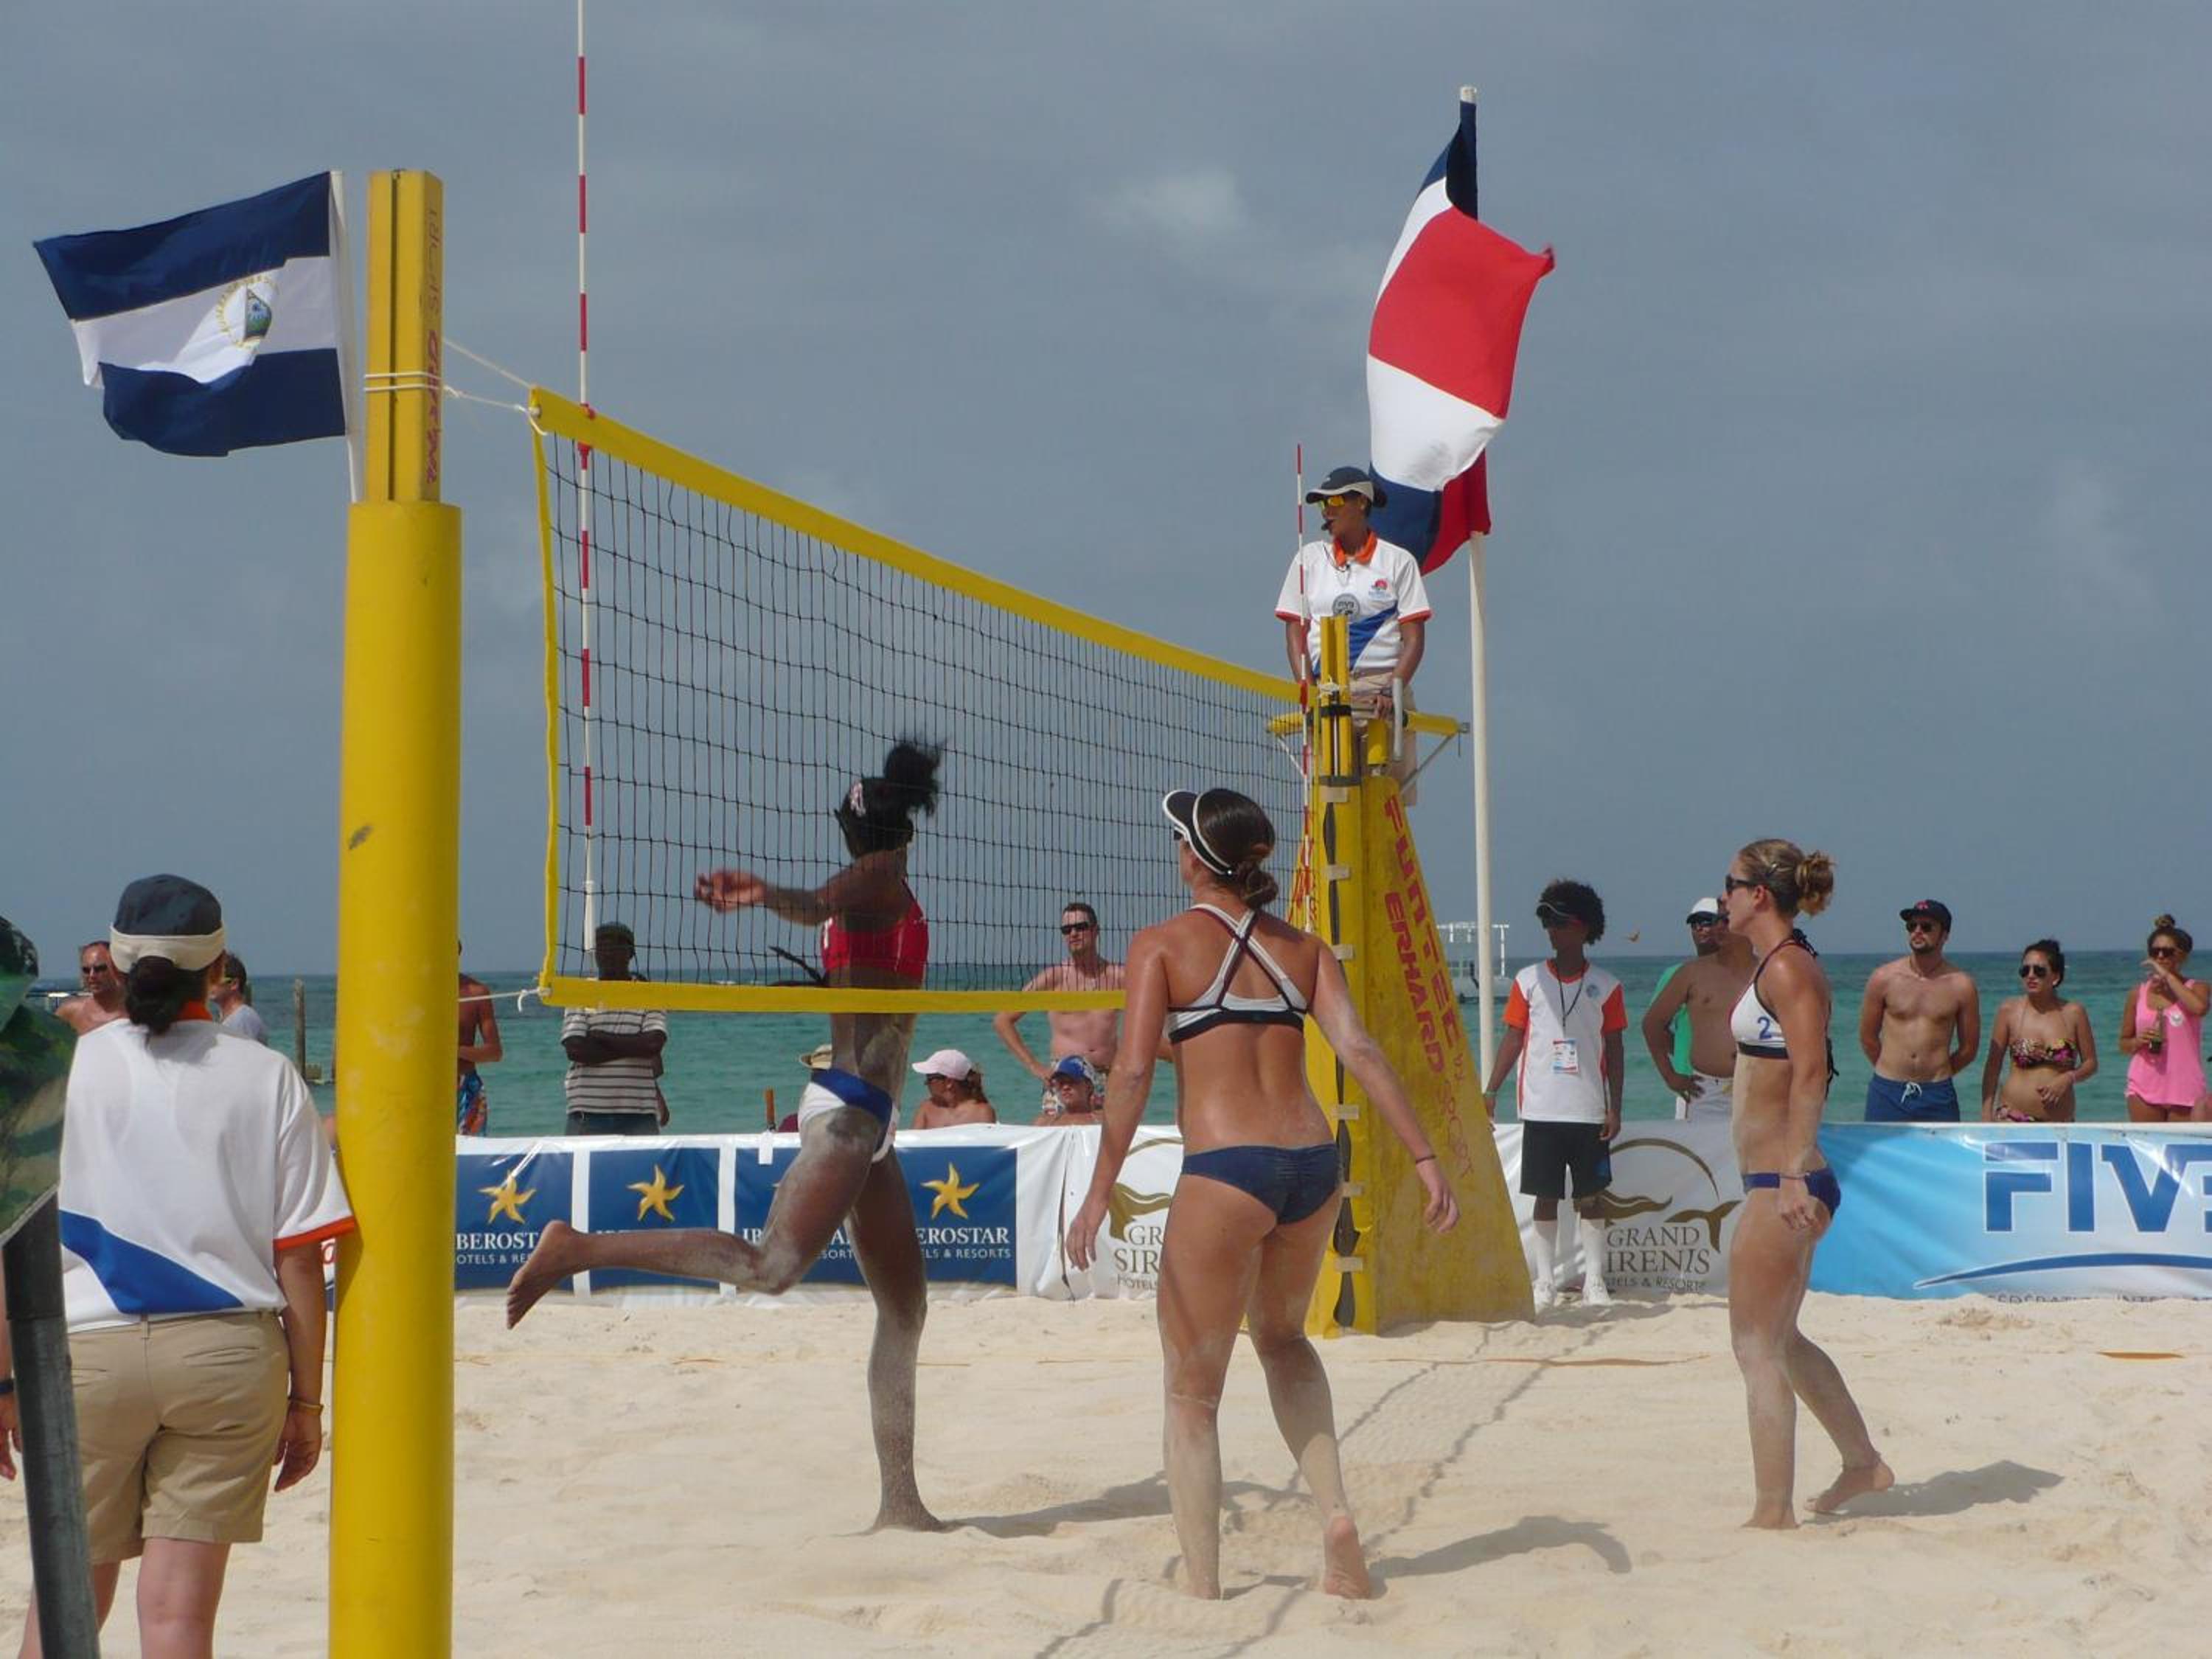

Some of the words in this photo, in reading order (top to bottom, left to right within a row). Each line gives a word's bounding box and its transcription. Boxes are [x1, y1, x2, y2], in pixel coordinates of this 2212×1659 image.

[1385, 891, 1445, 1073] ERHARD
[1757, 1016, 1772, 1040] 2
[1985, 1141, 2212, 1233] FIV
[456, 1233, 539, 1250] BEROST
[916, 1227, 1009, 1245] EROSTAR
[1129, 1225, 1164, 1245] GR
[1607, 1226, 1700, 1248] GRAND
[456, 1254, 495, 1265] OTELS
[956, 1248, 1011, 1259] RESORTS
[1114, 1248, 1160, 1274] SIR
[1605, 1248, 1710, 1275] IRENIS
